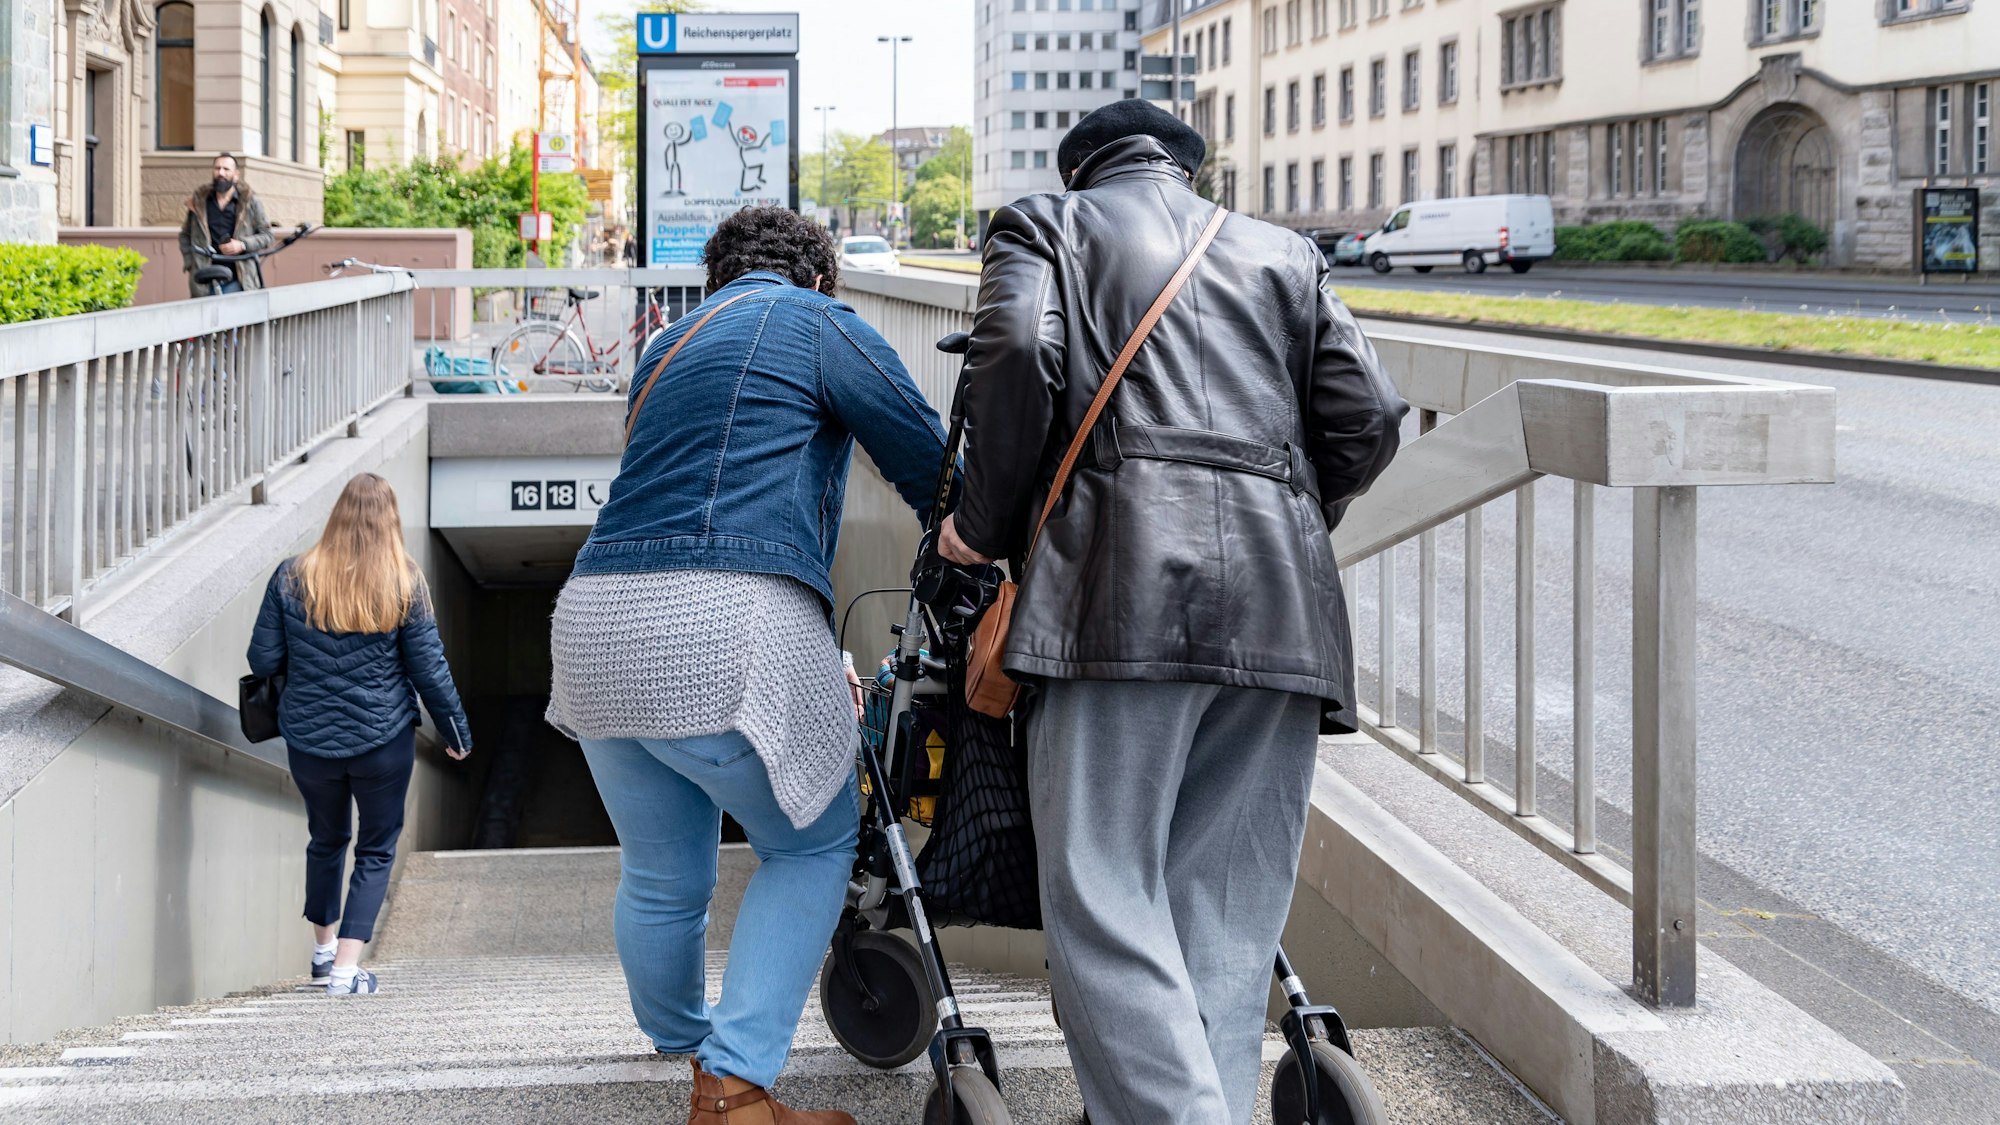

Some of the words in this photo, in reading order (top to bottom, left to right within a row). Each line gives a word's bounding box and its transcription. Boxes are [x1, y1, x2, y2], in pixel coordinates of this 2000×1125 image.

[644, 17, 670, 49] U
[683, 26, 793, 40] Reichenspergerplatz
[653, 98, 678, 108] QUALI
[680, 98, 691, 107] IST
[514, 485, 539, 506] 16
[548, 485, 574, 506] 18
